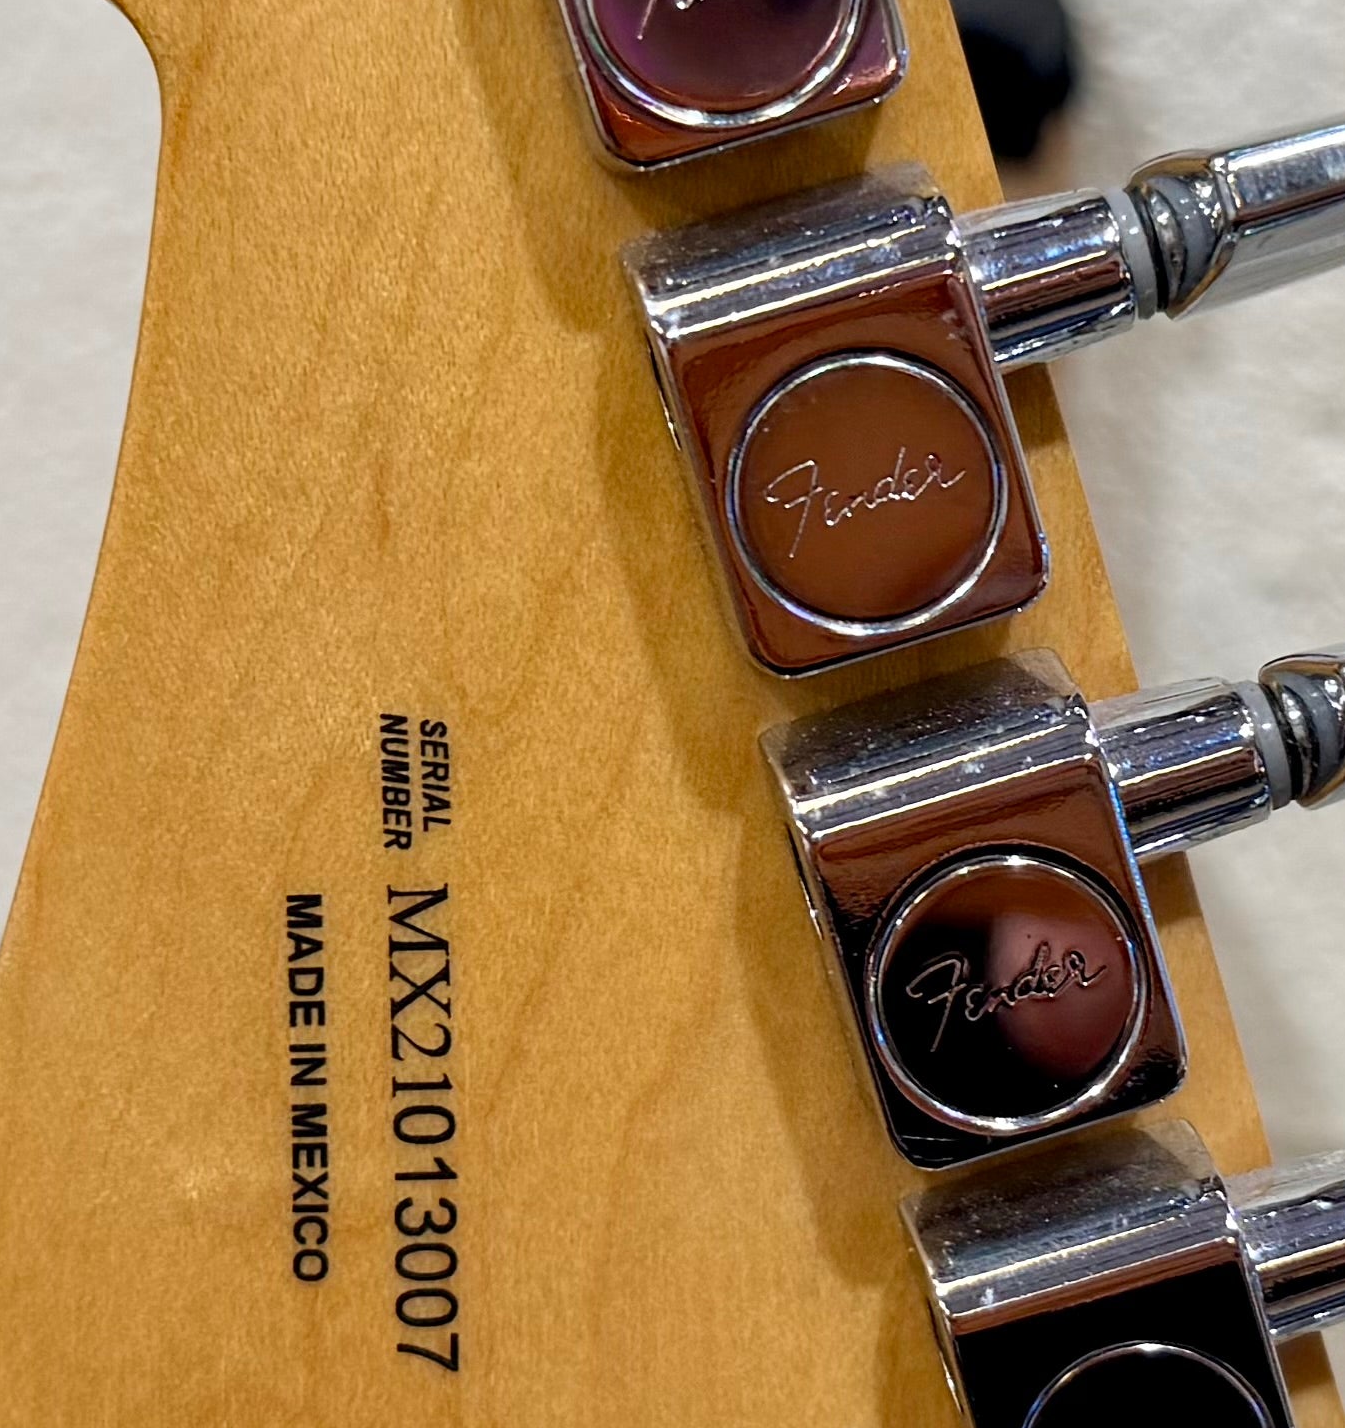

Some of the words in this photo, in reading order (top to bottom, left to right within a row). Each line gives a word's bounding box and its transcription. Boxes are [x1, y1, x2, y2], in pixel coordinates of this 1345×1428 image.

[763, 446, 967, 559] Fender
[378, 712, 412, 851] NUMBER
[418, 717, 452, 832] SERIAL
[285, 893, 326, 1028] MADE
[905, 940, 1108, 1053] Fender
[289, 1043, 328, 1087] IN
[386, 882, 460, 1372] MX21013007
[291, 1103, 329, 1283] MEXICO
